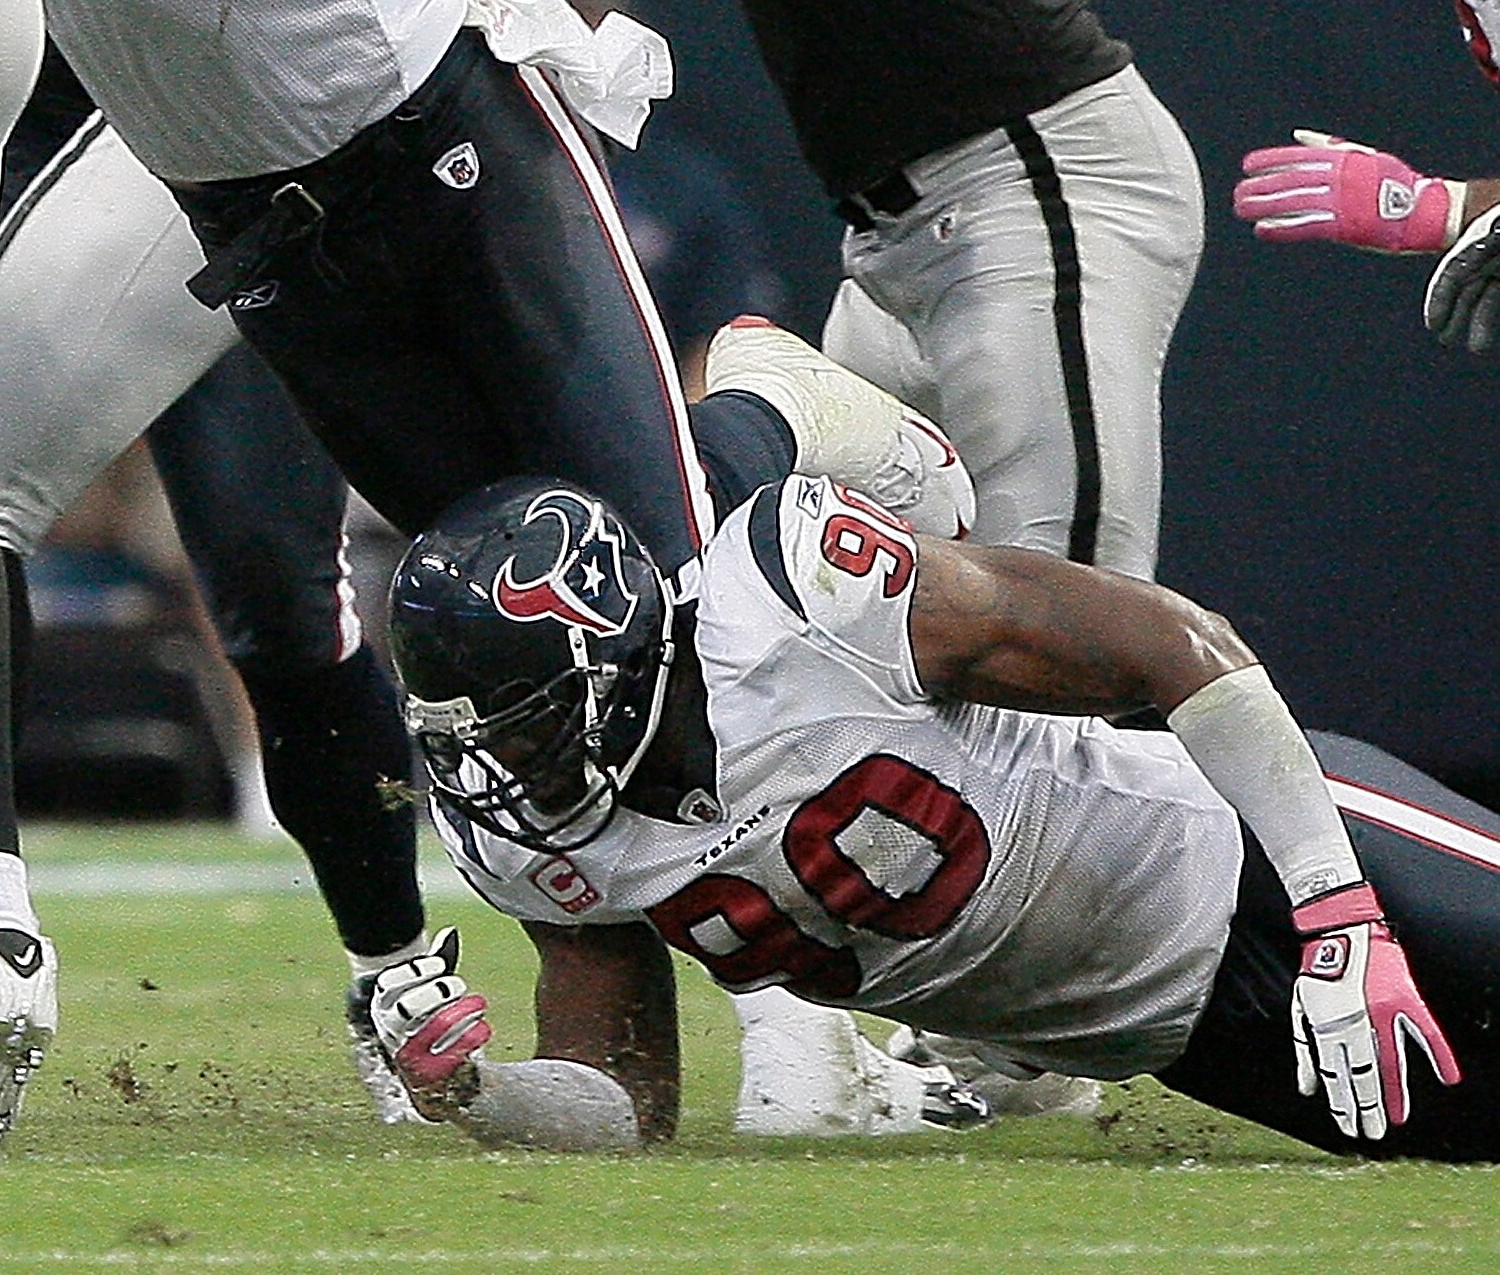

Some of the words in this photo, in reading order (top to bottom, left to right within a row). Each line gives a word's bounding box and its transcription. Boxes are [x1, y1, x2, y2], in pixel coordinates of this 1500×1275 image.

[694, 805, 771, 866] TEXANS
[535, 858, 587, 903] C
[643, 753, 993, 998] 90
